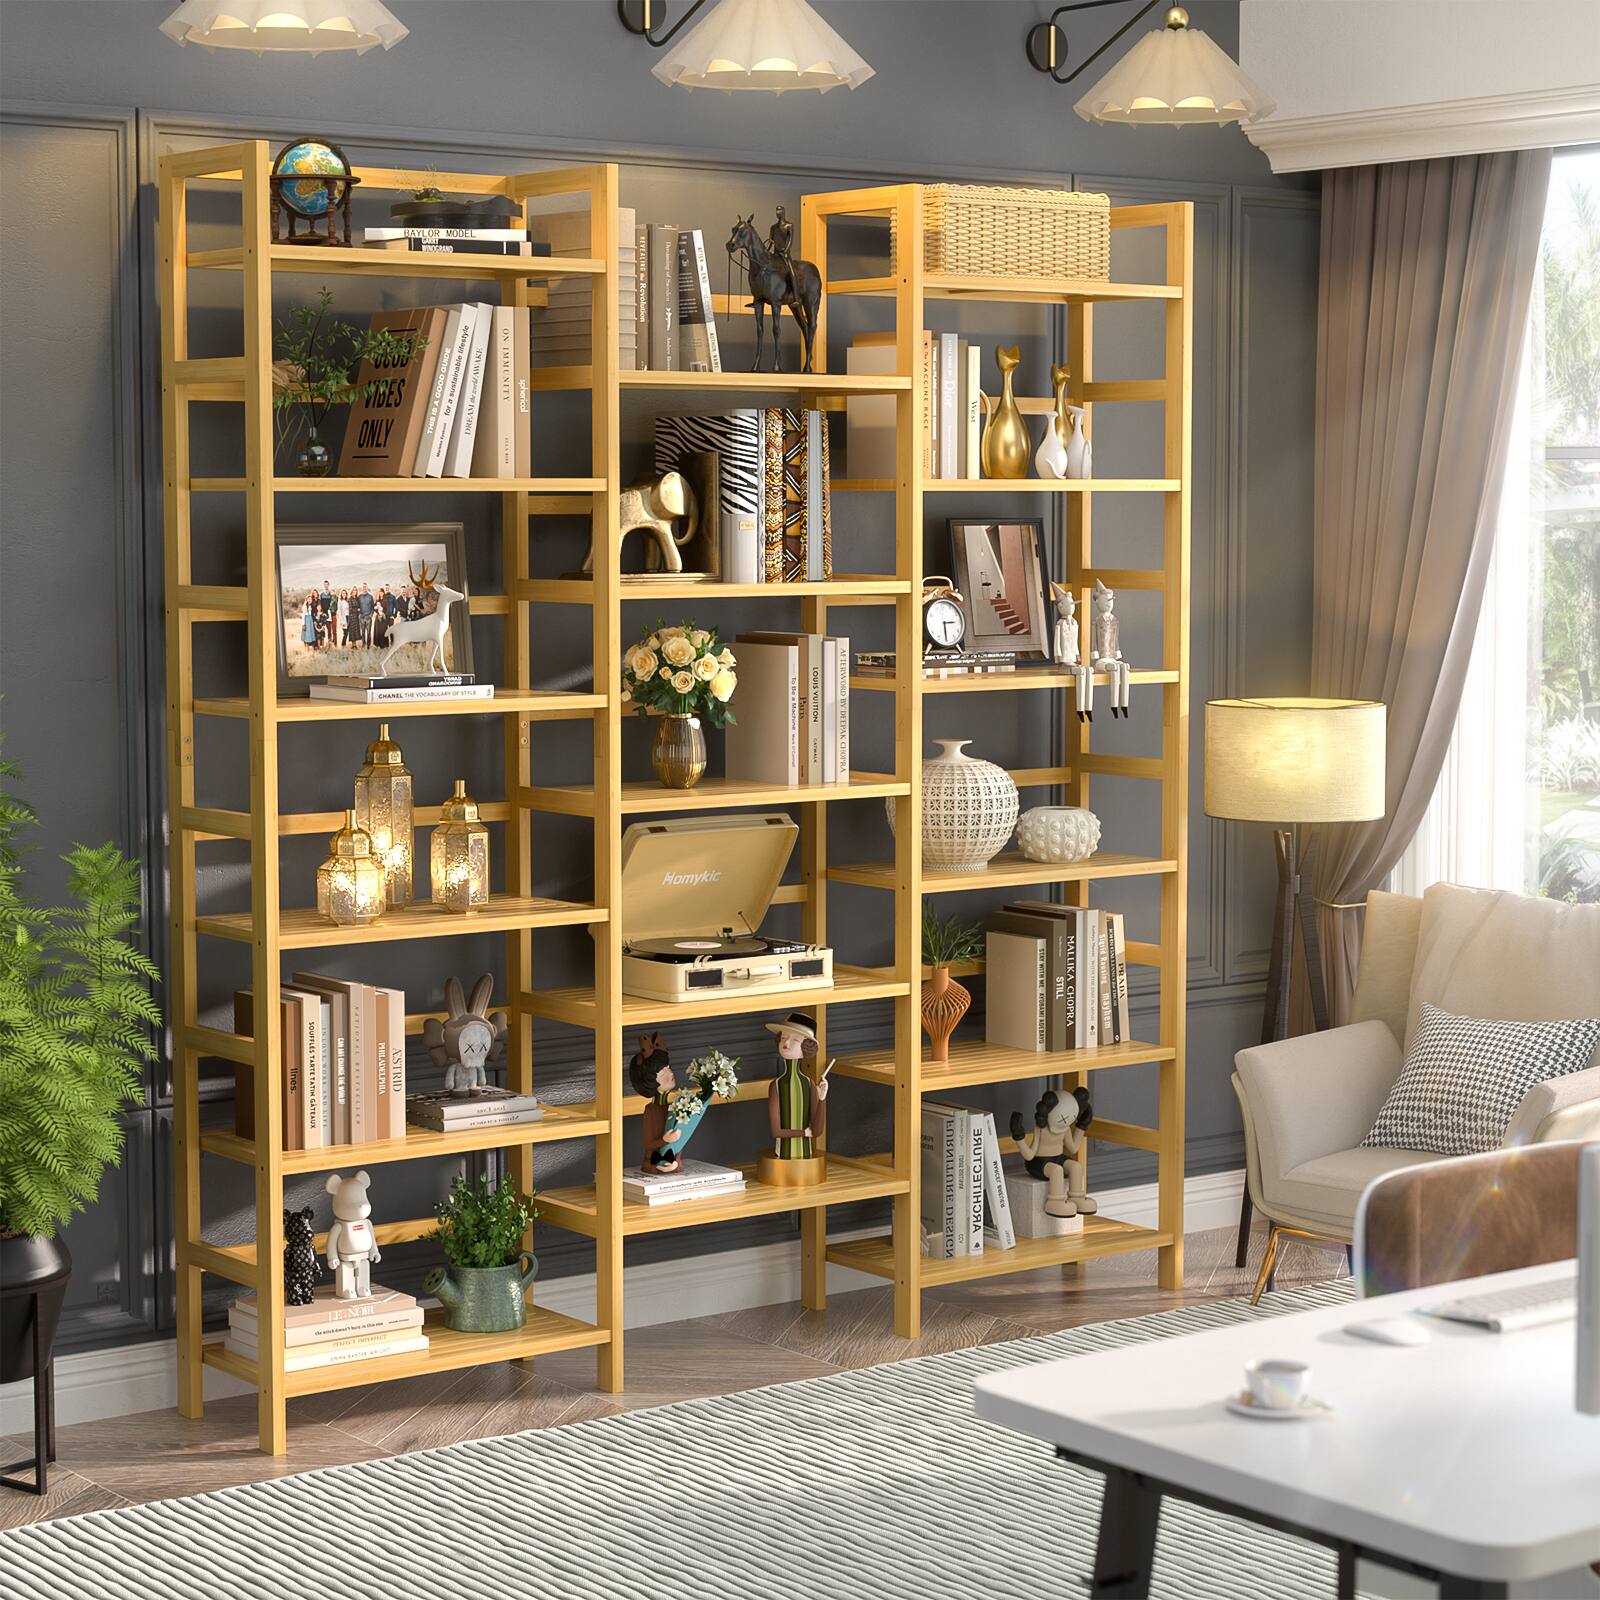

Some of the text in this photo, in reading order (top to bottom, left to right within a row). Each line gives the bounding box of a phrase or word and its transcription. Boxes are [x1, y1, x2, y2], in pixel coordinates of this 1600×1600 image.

[403, 229, 476, 238] BAYLOR MODEL
[697, 246, 706, 263] AFTER
[709, 332, 717, 352] AUTHOR
[440, 347, 452, 373] GUIDE
[443, 405, 451, 417] for
[449, 355, 463, 398] sustainable
[458, 325, 469, 354] lifestyle
[502, 328, 510, 401] ON IMMUNITY
[364, 378, 405, 409] VIBES
[434, 374, 445, 399] GOOD
[464, 404, 475, 436] DREAM
[472, 347, 483, 378] AWAKE
[517, 379, 528, 413] spherical
[944, 380, 955, 408] Dior
[430, 407, 438, 416] IS
[358, 419, 394, 448] ONLY
[427, 416, 436, 435] THIS
[791, 686, 797, 695] Be
[840, 698, 847, 707] BY
[662, 870, 721, 886] Homykic
[1039, 979, 1045, 988] ME
[1055, 976, 1064, 999] STILL
[1098, 933, 1112, 1029] Sigrid Rausing mayhem
[337, 1037, 345, 1048] CAN
[337, 1057, 345, 1076] CHANGE
[378, 1042, 386, 1095] PHILADELPHIA
[392, 1048, 403, 1092] ASTRID
[290, 1067, 299, 1094] lines.
[337, 1076, 345, 1086] THE
[333, 1334, 387, 1348] PERFECT IMPERFECT
